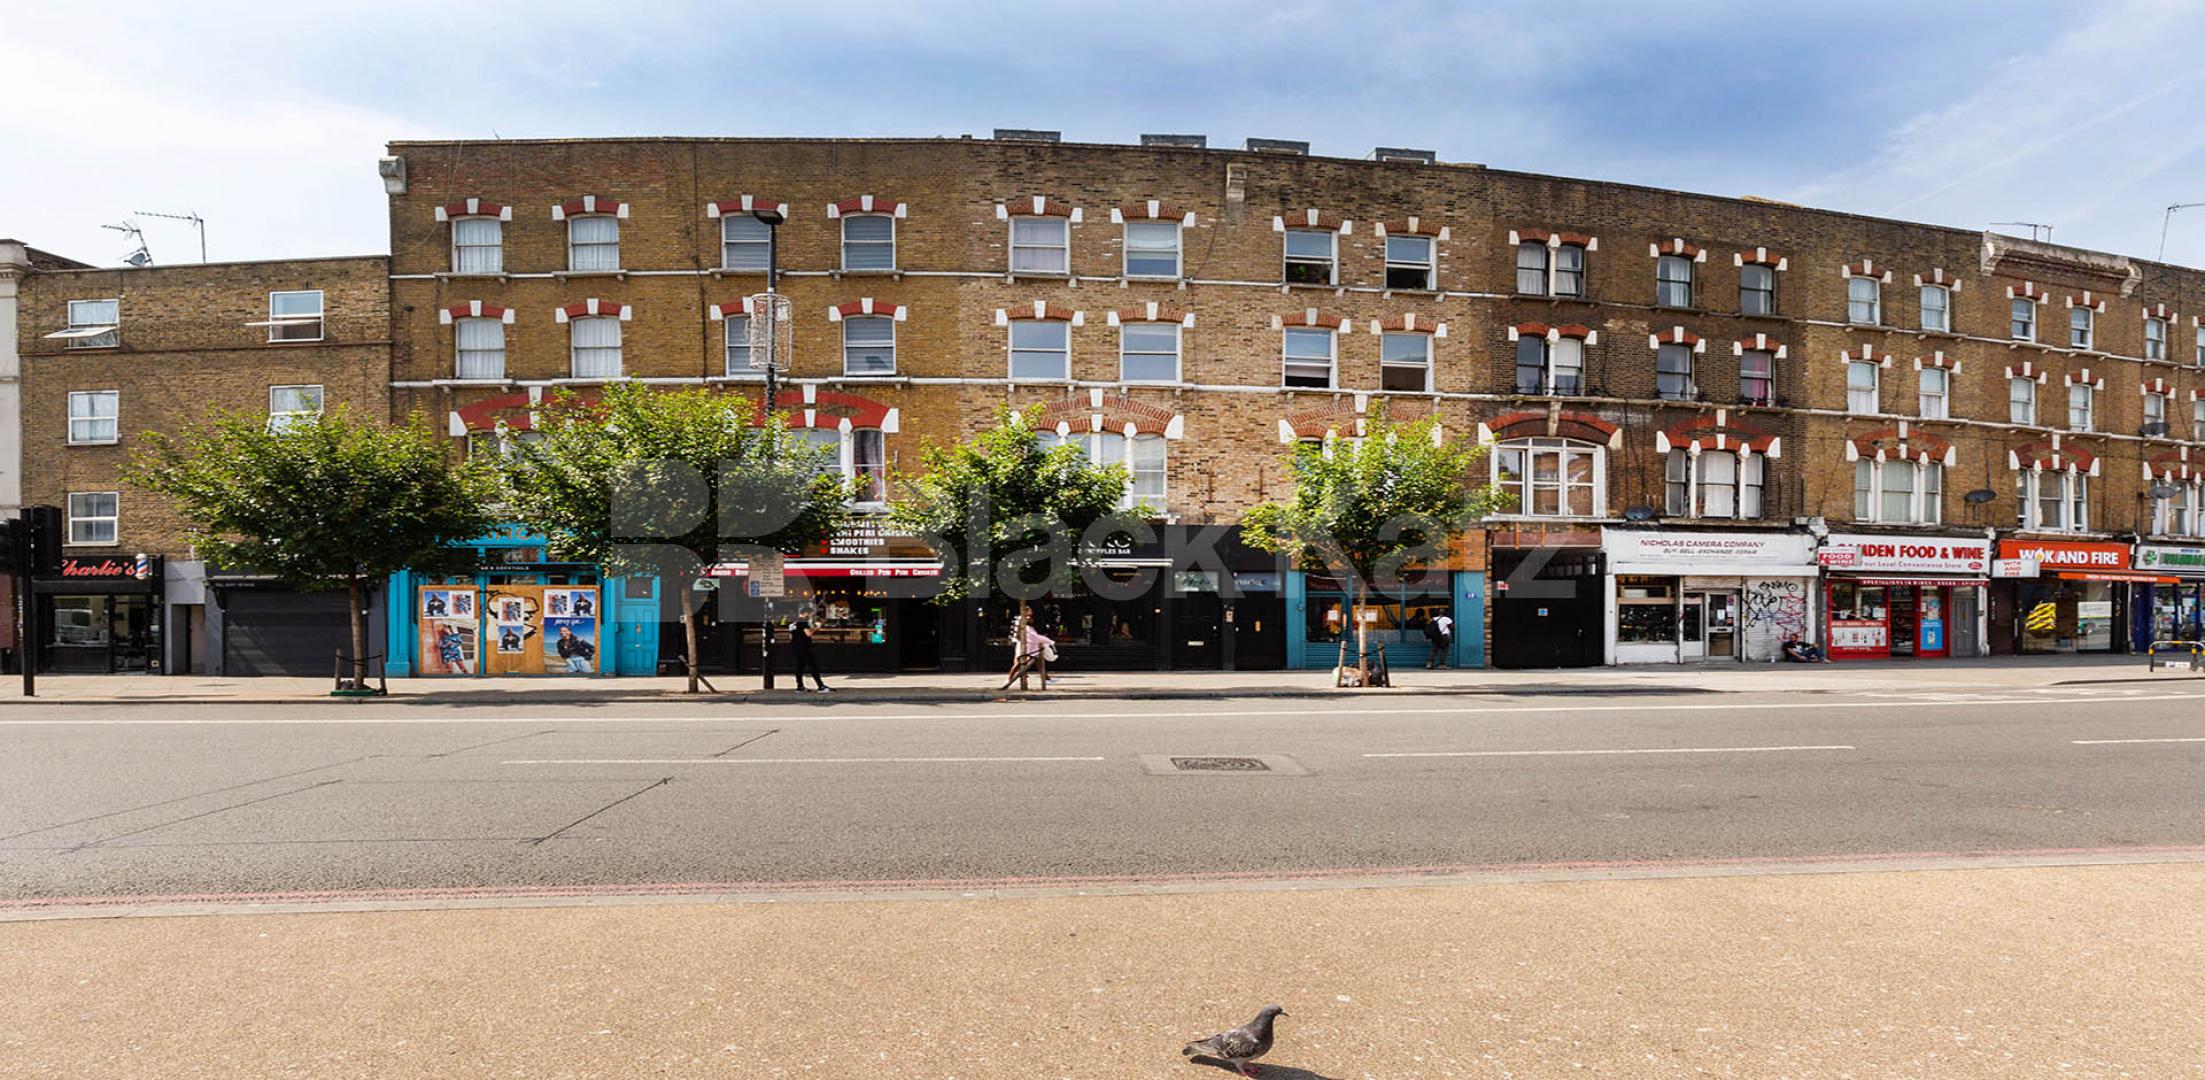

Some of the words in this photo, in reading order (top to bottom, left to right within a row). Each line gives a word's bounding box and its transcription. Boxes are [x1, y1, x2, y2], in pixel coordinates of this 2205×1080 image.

[830, 538, 885, 546] SMOOTHIES
[1640, 539, 1684, 547] NICHOLAS
[829, 547, 870, 555] SHAKES
[1899, 545, 1936, 559] FOOD
[1940, 546, 1949, 559] &
[1952, 546, 1985, 560] WINE
[2056, 551, 2089, 564] AND
[2091, 552, 2119, 565] FIRE
